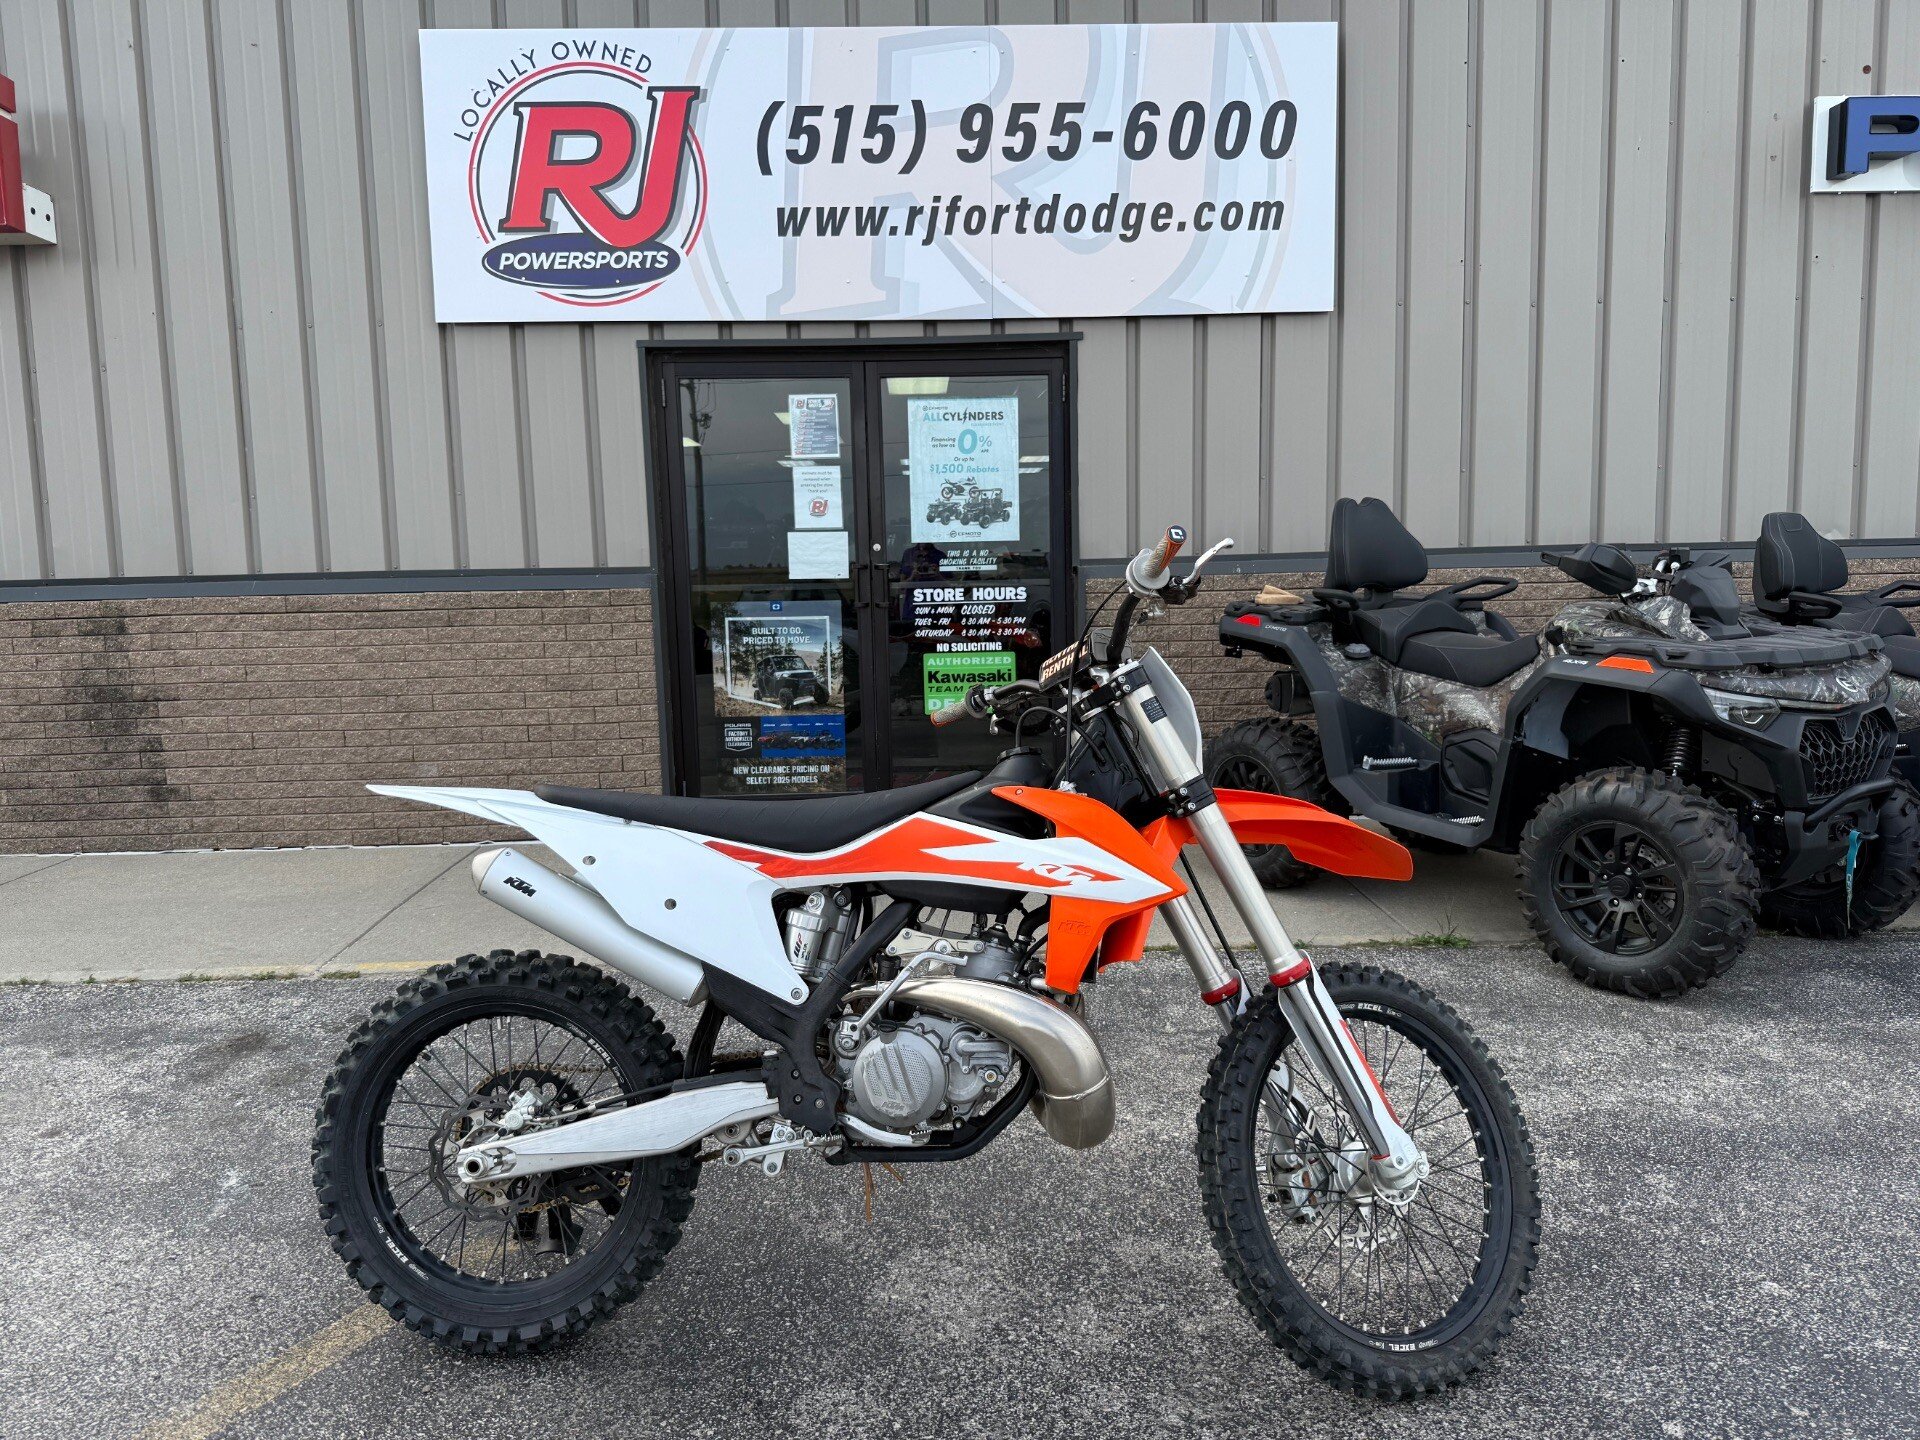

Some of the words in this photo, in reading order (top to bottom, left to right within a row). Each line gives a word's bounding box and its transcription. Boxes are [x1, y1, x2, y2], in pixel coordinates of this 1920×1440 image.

[454, 48, 537, 142] LOCALLY
[551, 39, 652, 74] OWNED
[757, 99, 928, 176] (515)
[956, 100, 1298, 163] 955-6000
[498, 85, 701, 249] RJ
[776, 193, 1286, 247] www.rjfortdodge.com
[499, 251, 669, 270] POWERSPORTS
[930, 463, 964, 474] $1,500
[966, 465, 1000, 473] Rebates
[946, 550, 961, 558] THIS
[972, 549, 977, 557] A
[979, 549, 989, 557] NO
[939, 558, 967, 566] SMOKING
[969, 557, 997, 565] FACILITY
[913, 588, 965, 602] STORE
[972, 587, 1027, 600] HOURS
[914, 606, 930, 615] SUN
[936, 606, 955, 614] MON
[961, 604, 996, 614] CLOSED
[914, 618, 932, 626] TUES
[938, 618, 951, 626] FRI
[977, 617, 991, 625] AM
[1012, 616, 1027, 624] PM
[752, 627, 775, 635] BUILT
[777, 627, 787, 635] TO
[914, 628, 954, 637] SATURDAY
[977, 628, 991, 636] AM
[1013, 628, 1027, 636] PM
[743, 636, 774, 645] PRICED
[775, 636, 786, 644] TO
[936, 642, 949, 652] NO
[951, 641, 1002, 652] SOLICITING
[927, 656, 1012, 666] AUTHORIZED
[1042, 644, 1089, 680] RENTHL
[927, 668, 1012, 684] Kawasaki
[928, 685, 964, 693] TEAM
[733, 766, 750, 775] NEW
[750, 766, 790, 774] CLEARANCE
[792, 765, 819, 773] PRICING
[820, 764, 830, 773] ON
[746, 776, 771, 785] SELECT
[773, 776, 790, 784] 2025
[791, 775, 818, 783] MODELS
[503, 875, 537, 898] KTM
[1357, 1002, 1383, 1013] EXCEL
[587, 1037, 612, 1064] EXCEL
[385, 1235, 409, 1264] EXCEL
[1388, 1343, 1417, 1351] EXCEL
